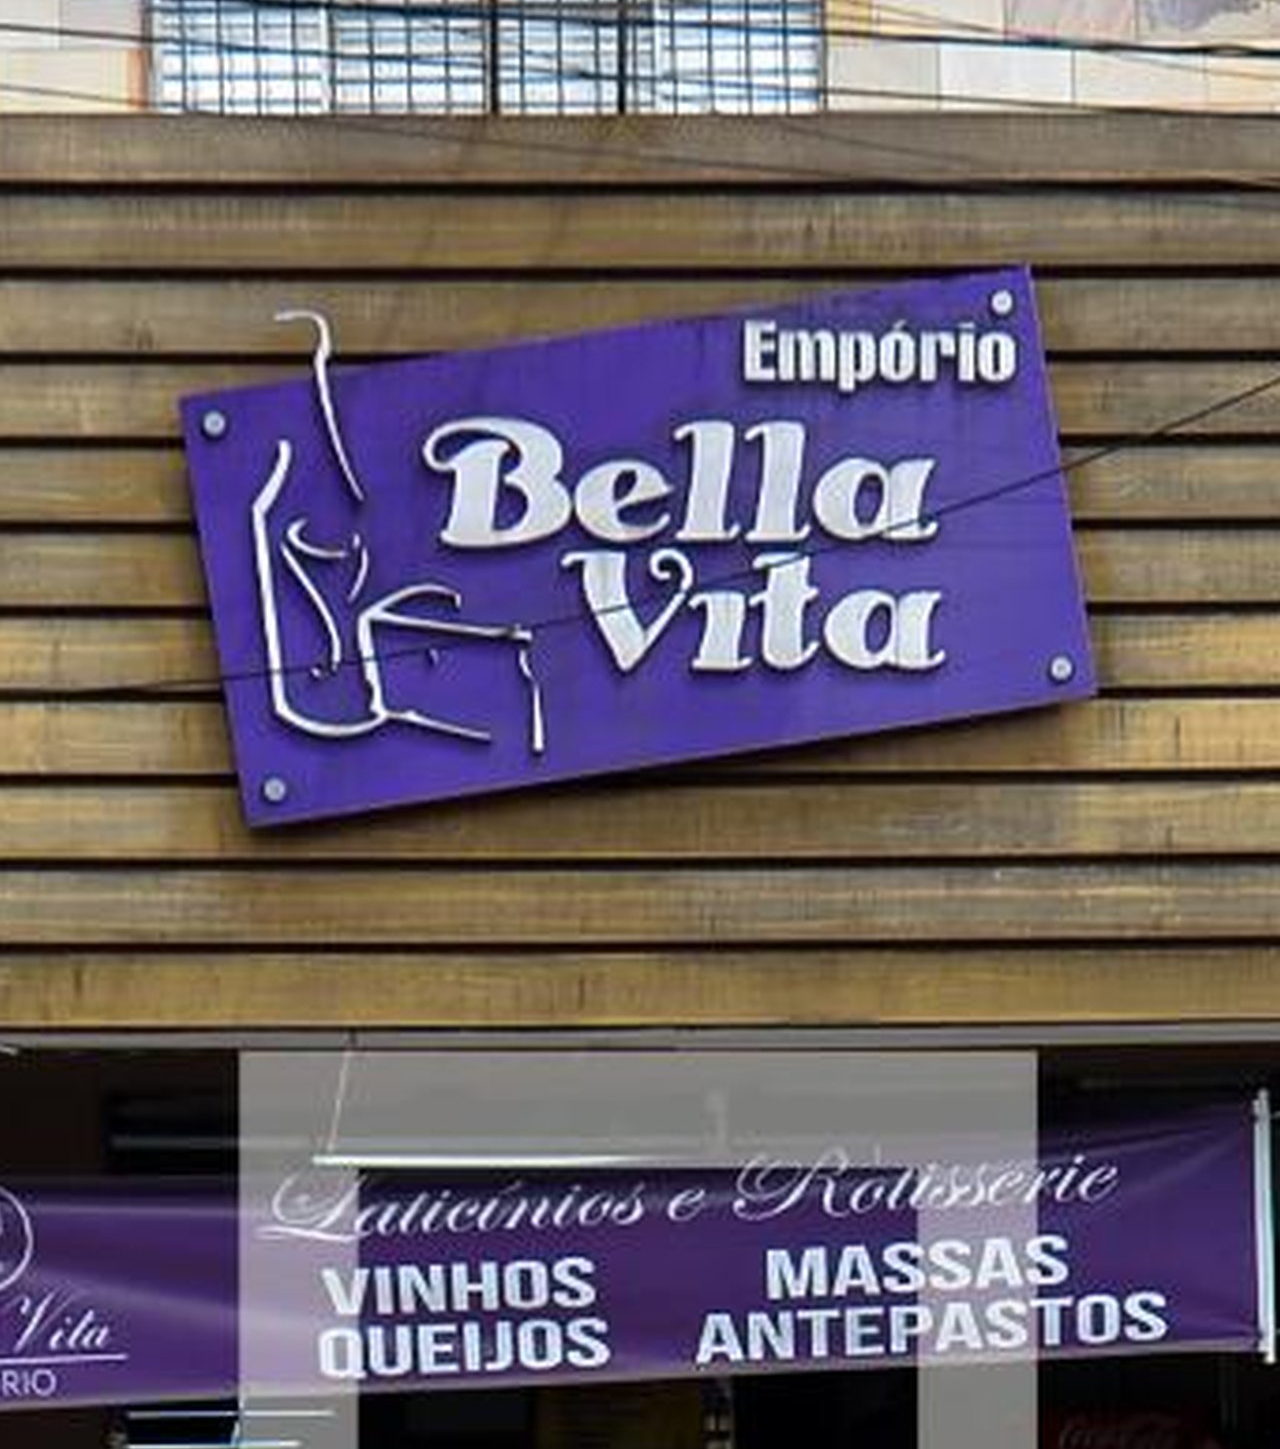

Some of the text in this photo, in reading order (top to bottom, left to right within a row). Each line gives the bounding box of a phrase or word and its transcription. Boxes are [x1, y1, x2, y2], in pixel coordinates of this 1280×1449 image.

[742, 317, 1017, 392] Empório
[422, 415, 941, 549] Bella
[561, 548, 947, 675] Vita
[667, 1186, 706, 1222] e
[321, 1233, 1070, 1316] VINHOS MASSAS
[0, 1288, 111, 1353] Vita
[318, 1291, 1168, 1380] QUEIJOS ANTEPASTOS
